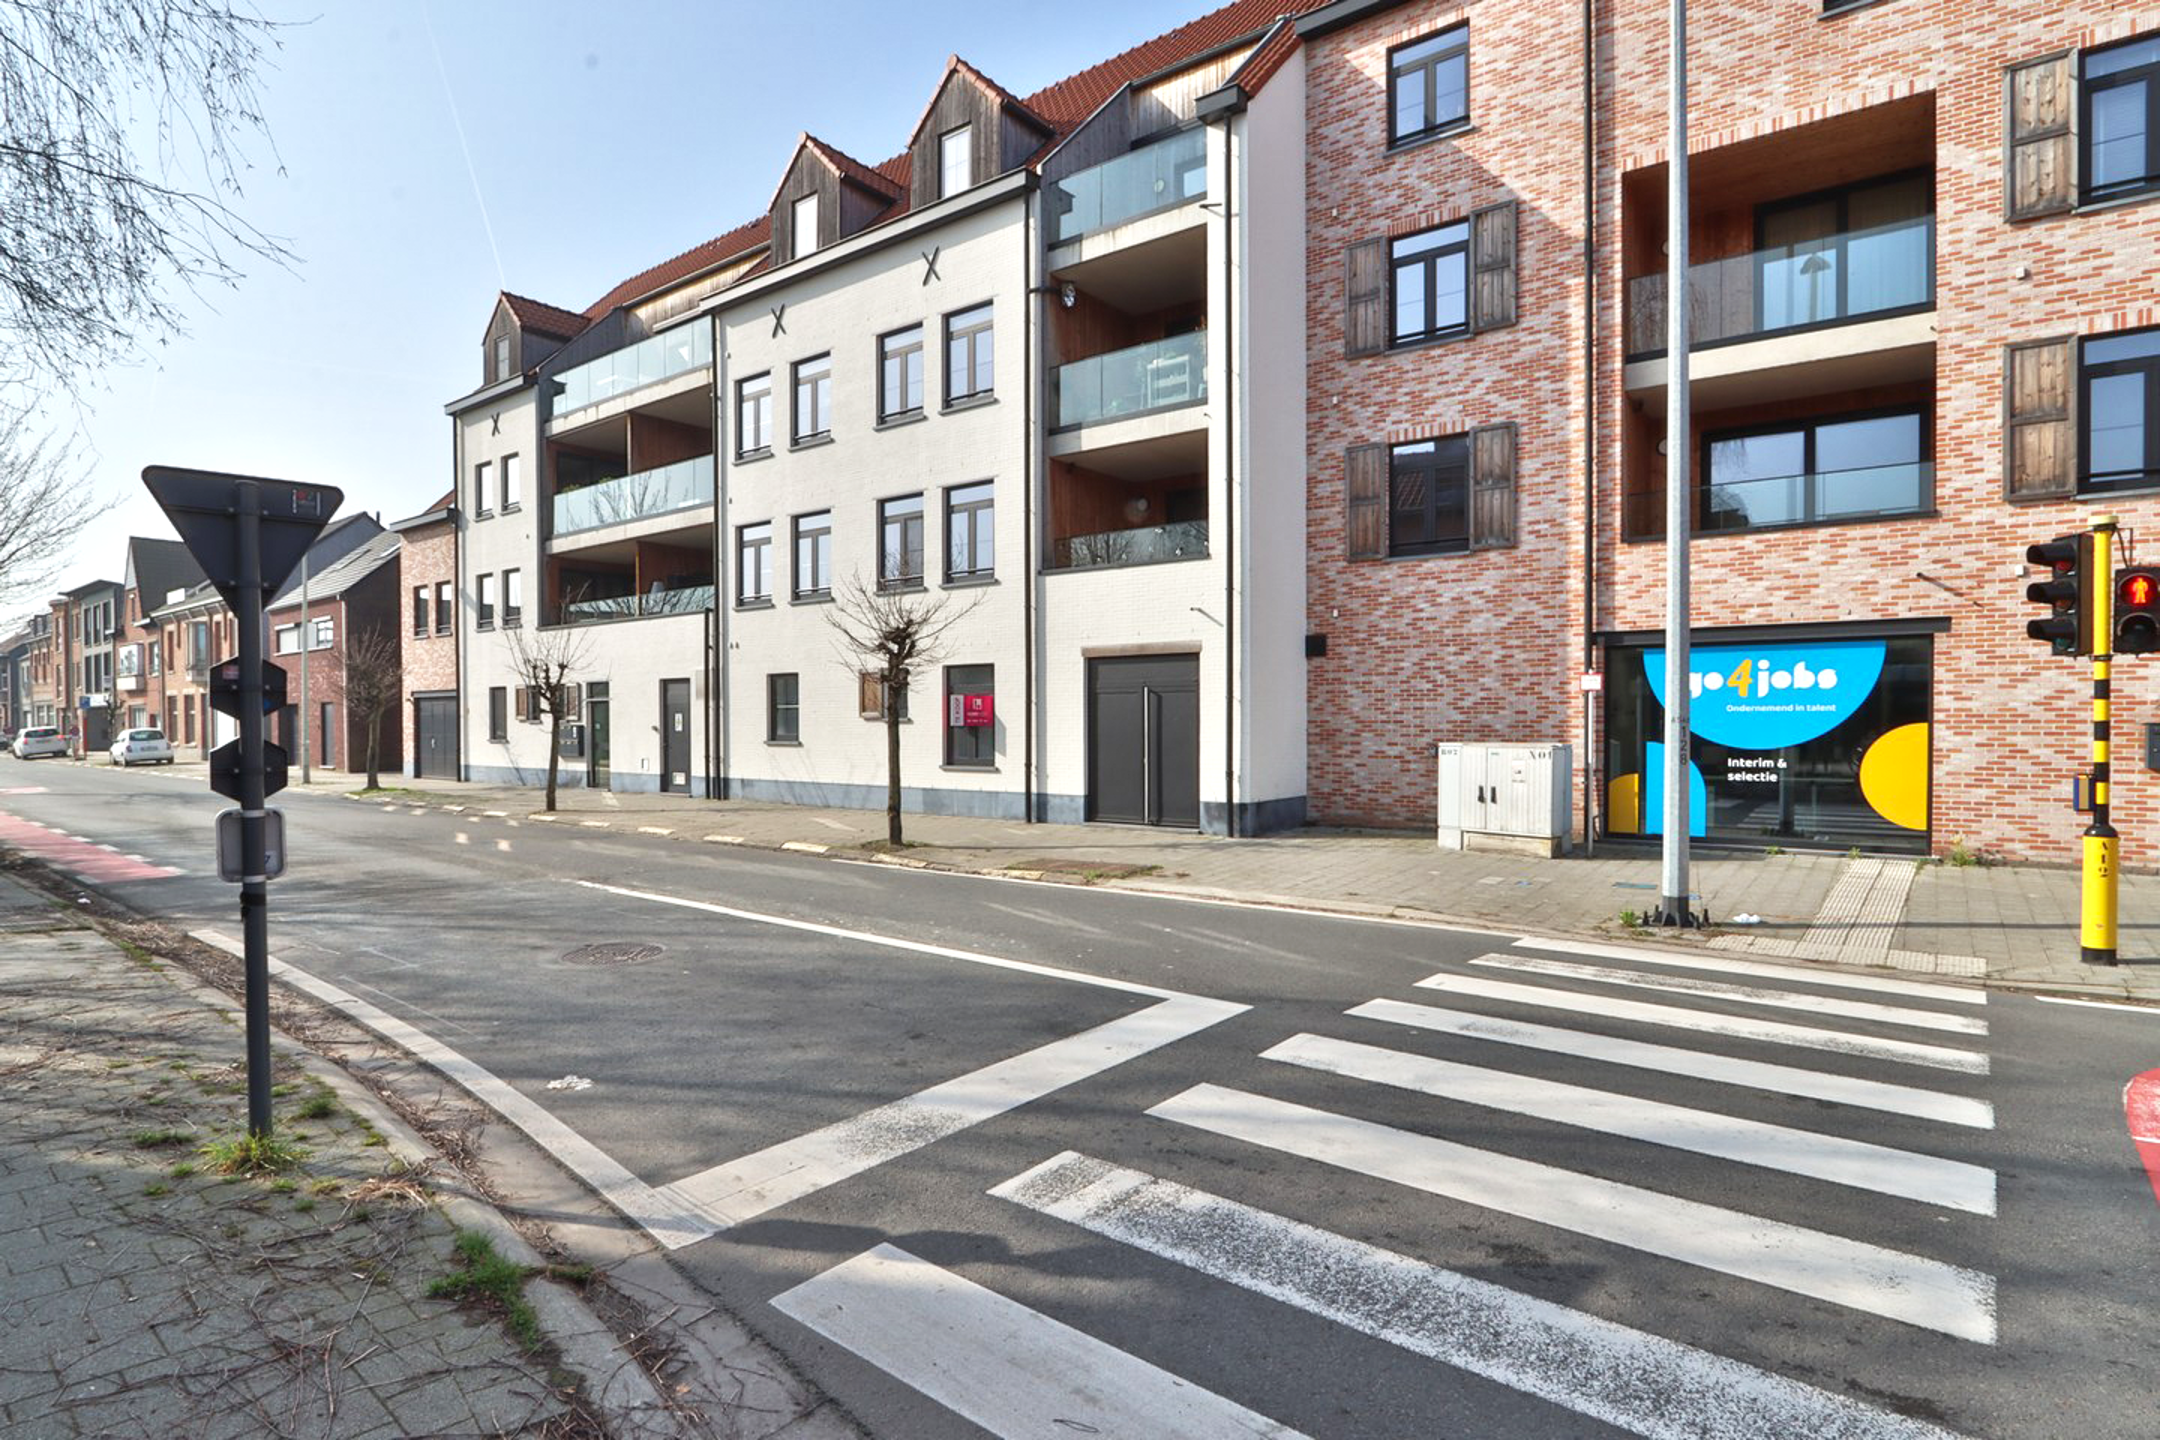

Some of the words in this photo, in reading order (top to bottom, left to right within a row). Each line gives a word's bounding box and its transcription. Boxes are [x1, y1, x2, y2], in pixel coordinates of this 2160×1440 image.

[1726, 704, 1794, 712] Ondernemend
[1795, 704, 1805, 712] in
[1806, 704, 1837, 712] talent
[1680, 725, 1688, 765] 128
[1727, 757, 1775, 768] Interim
[1777, 758, 1788, 768] &
[1727, 771, 1778, 782] selectie
